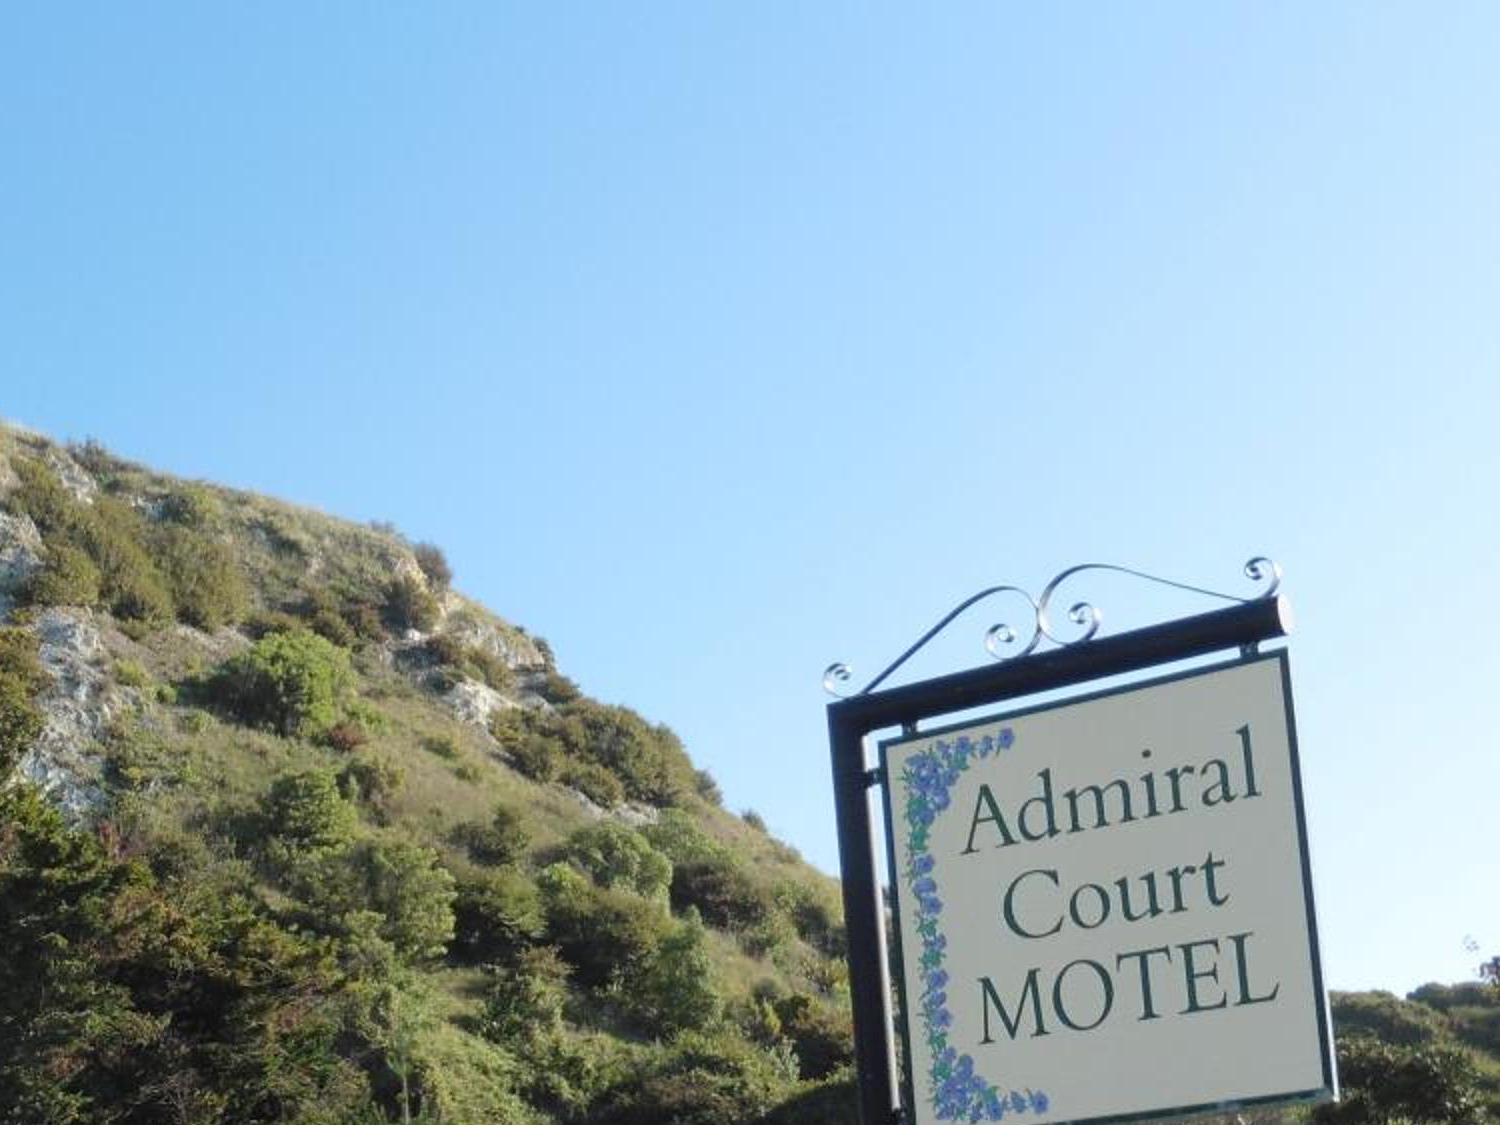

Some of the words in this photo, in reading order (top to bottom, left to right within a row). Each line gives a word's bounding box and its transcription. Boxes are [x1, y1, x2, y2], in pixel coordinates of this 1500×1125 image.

[959, 723, 1262, 855] Admiral
[1003, 852, 1231, 938] Court
[977, 932, 1280, 1044] MOTEL
